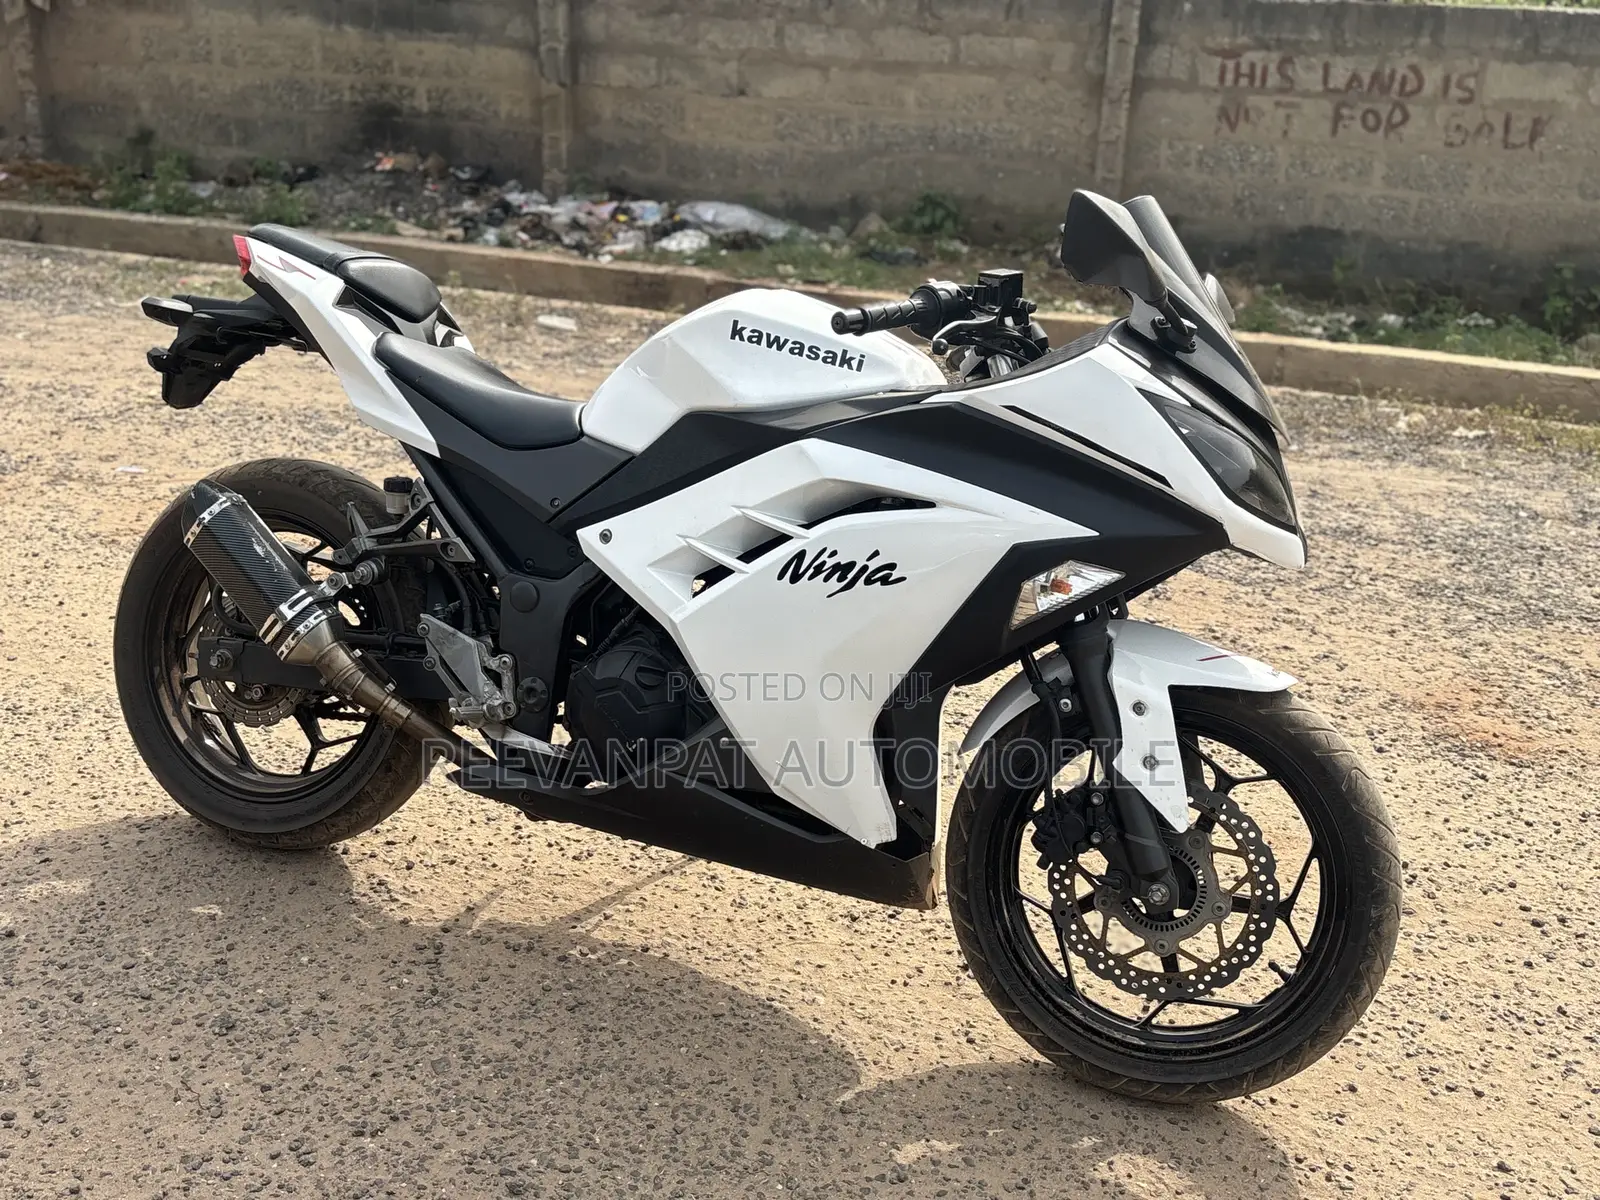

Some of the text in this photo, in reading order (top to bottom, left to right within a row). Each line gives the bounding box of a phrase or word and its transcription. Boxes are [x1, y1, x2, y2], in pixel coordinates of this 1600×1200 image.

[1205, 48, 1479, 105] THIS LAND IS
[1330, 100, 1412, 142] FOR
[729, 318, 867, 374] kawasaki
[776, 546, 908, 599] Ninja
